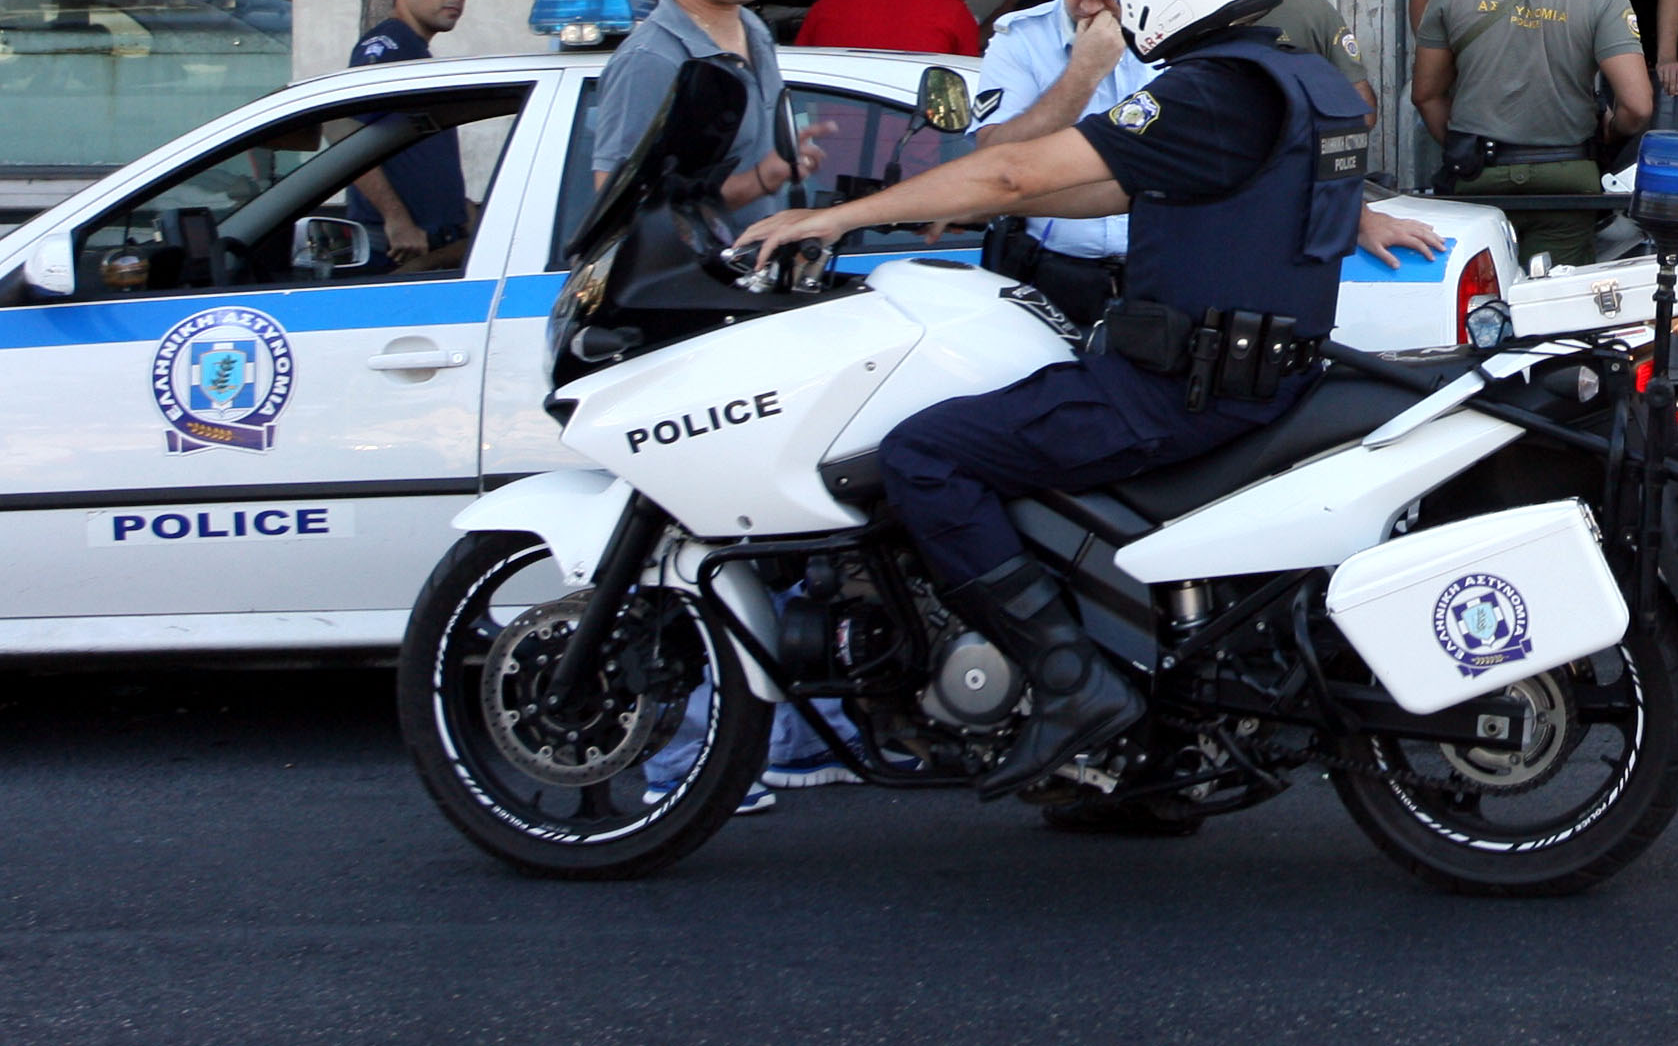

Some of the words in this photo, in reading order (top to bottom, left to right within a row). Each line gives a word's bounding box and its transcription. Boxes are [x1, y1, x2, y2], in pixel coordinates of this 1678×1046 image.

[1477, 0, 1568, 23] ΑΣΥΝΟΜΙΑ
[153, 312, 216, 421] ΕΛΛΗΝΙΚΗ
[222, 311, 291, 417] ΑΣΤΥΝΟΜΙΑ
[625, 390, 783, 454] POLICE
[113, 508, 330, 541] POLICE
[1464, 574, 1527, 636] ΑΣΤΥΝΟΜΙΑ
